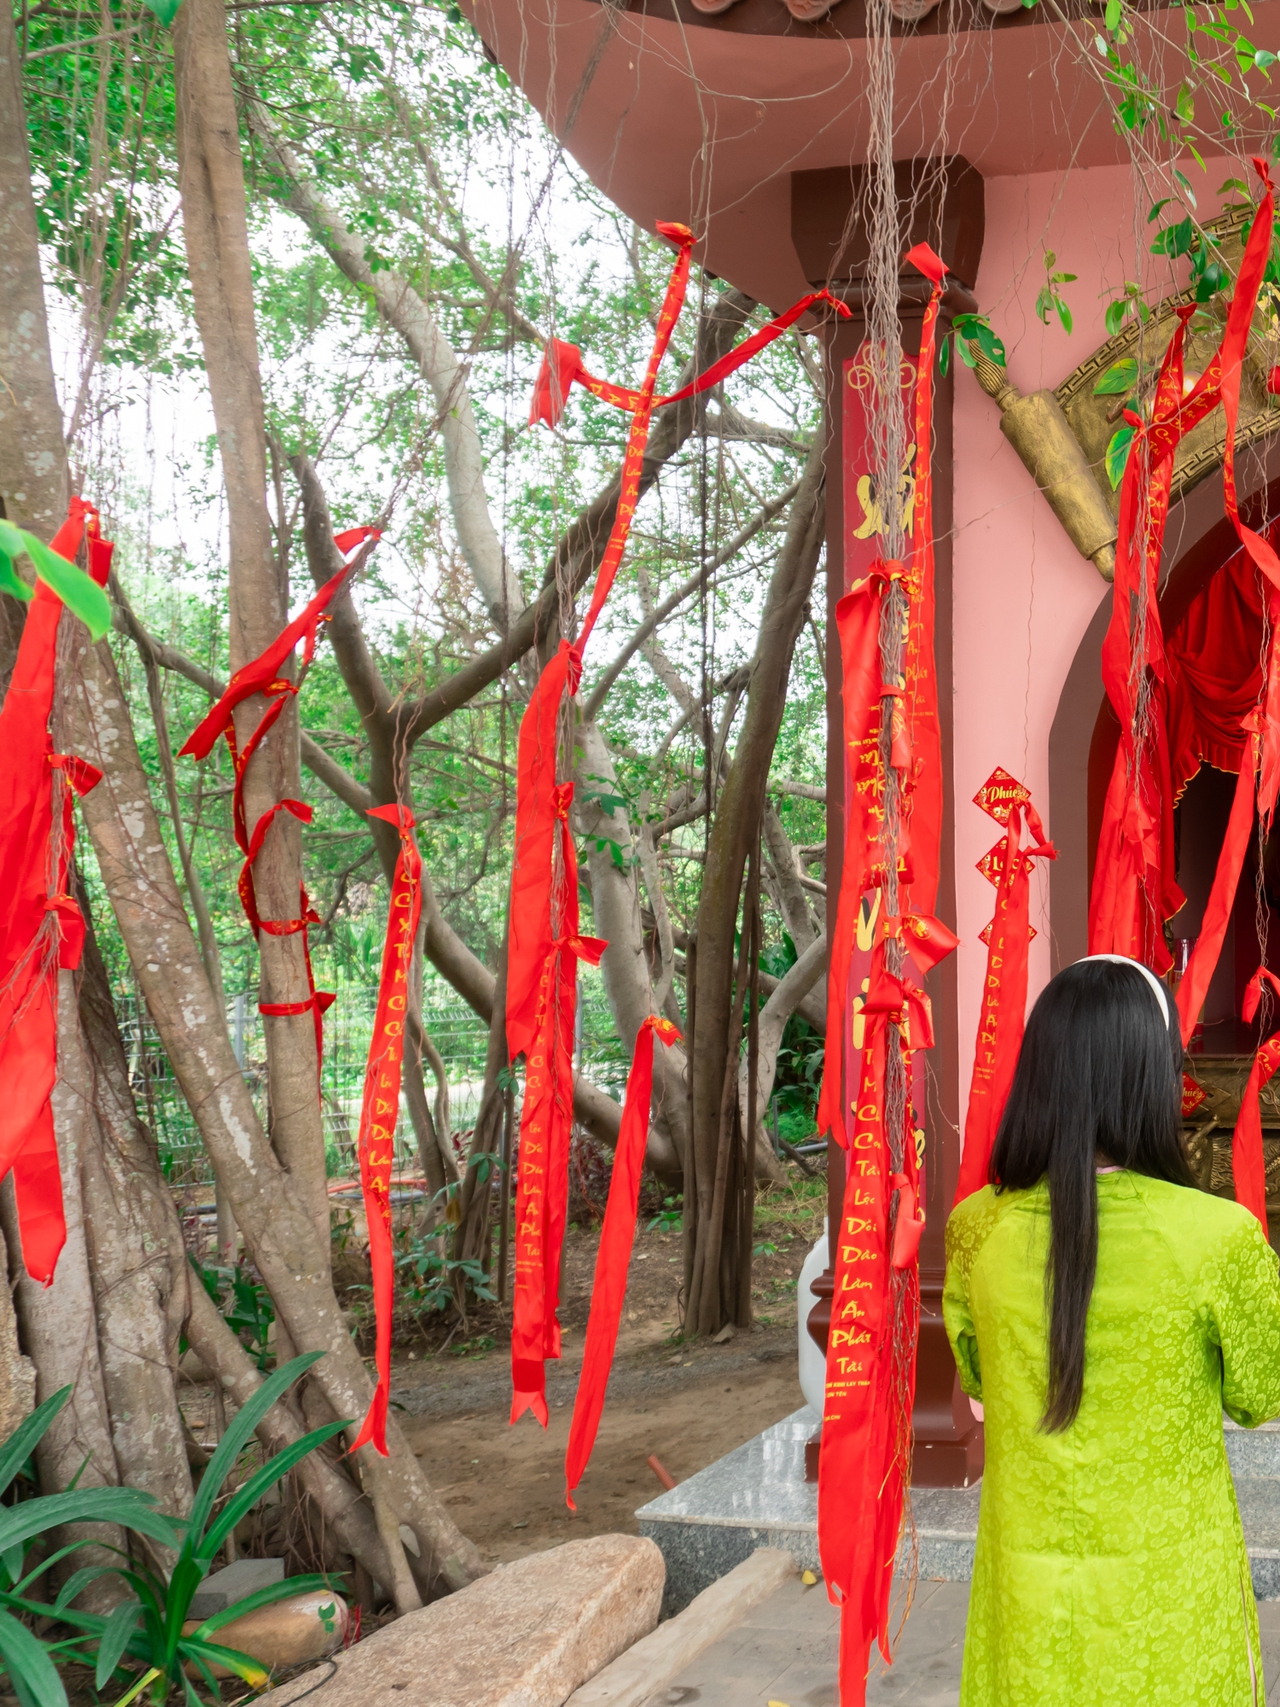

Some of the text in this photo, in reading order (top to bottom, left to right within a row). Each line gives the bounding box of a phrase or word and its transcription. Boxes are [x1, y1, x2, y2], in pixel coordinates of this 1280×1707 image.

[988, 785, 1021, 802] Phúc
[1182, 1087, 1197, 1099] húc
[855, 1188, 875, 1206] Lộc
[846, 1217, 877, 1235] Dồi
[841, 1246, 877, 1263] Dào
[842, 1274, 873, 1291] Làm
[841, 1300, 865, 1319] Ăn
[831, 1325, 871, 1348] Phát
[836, 1357, 863, 1375] Tài
